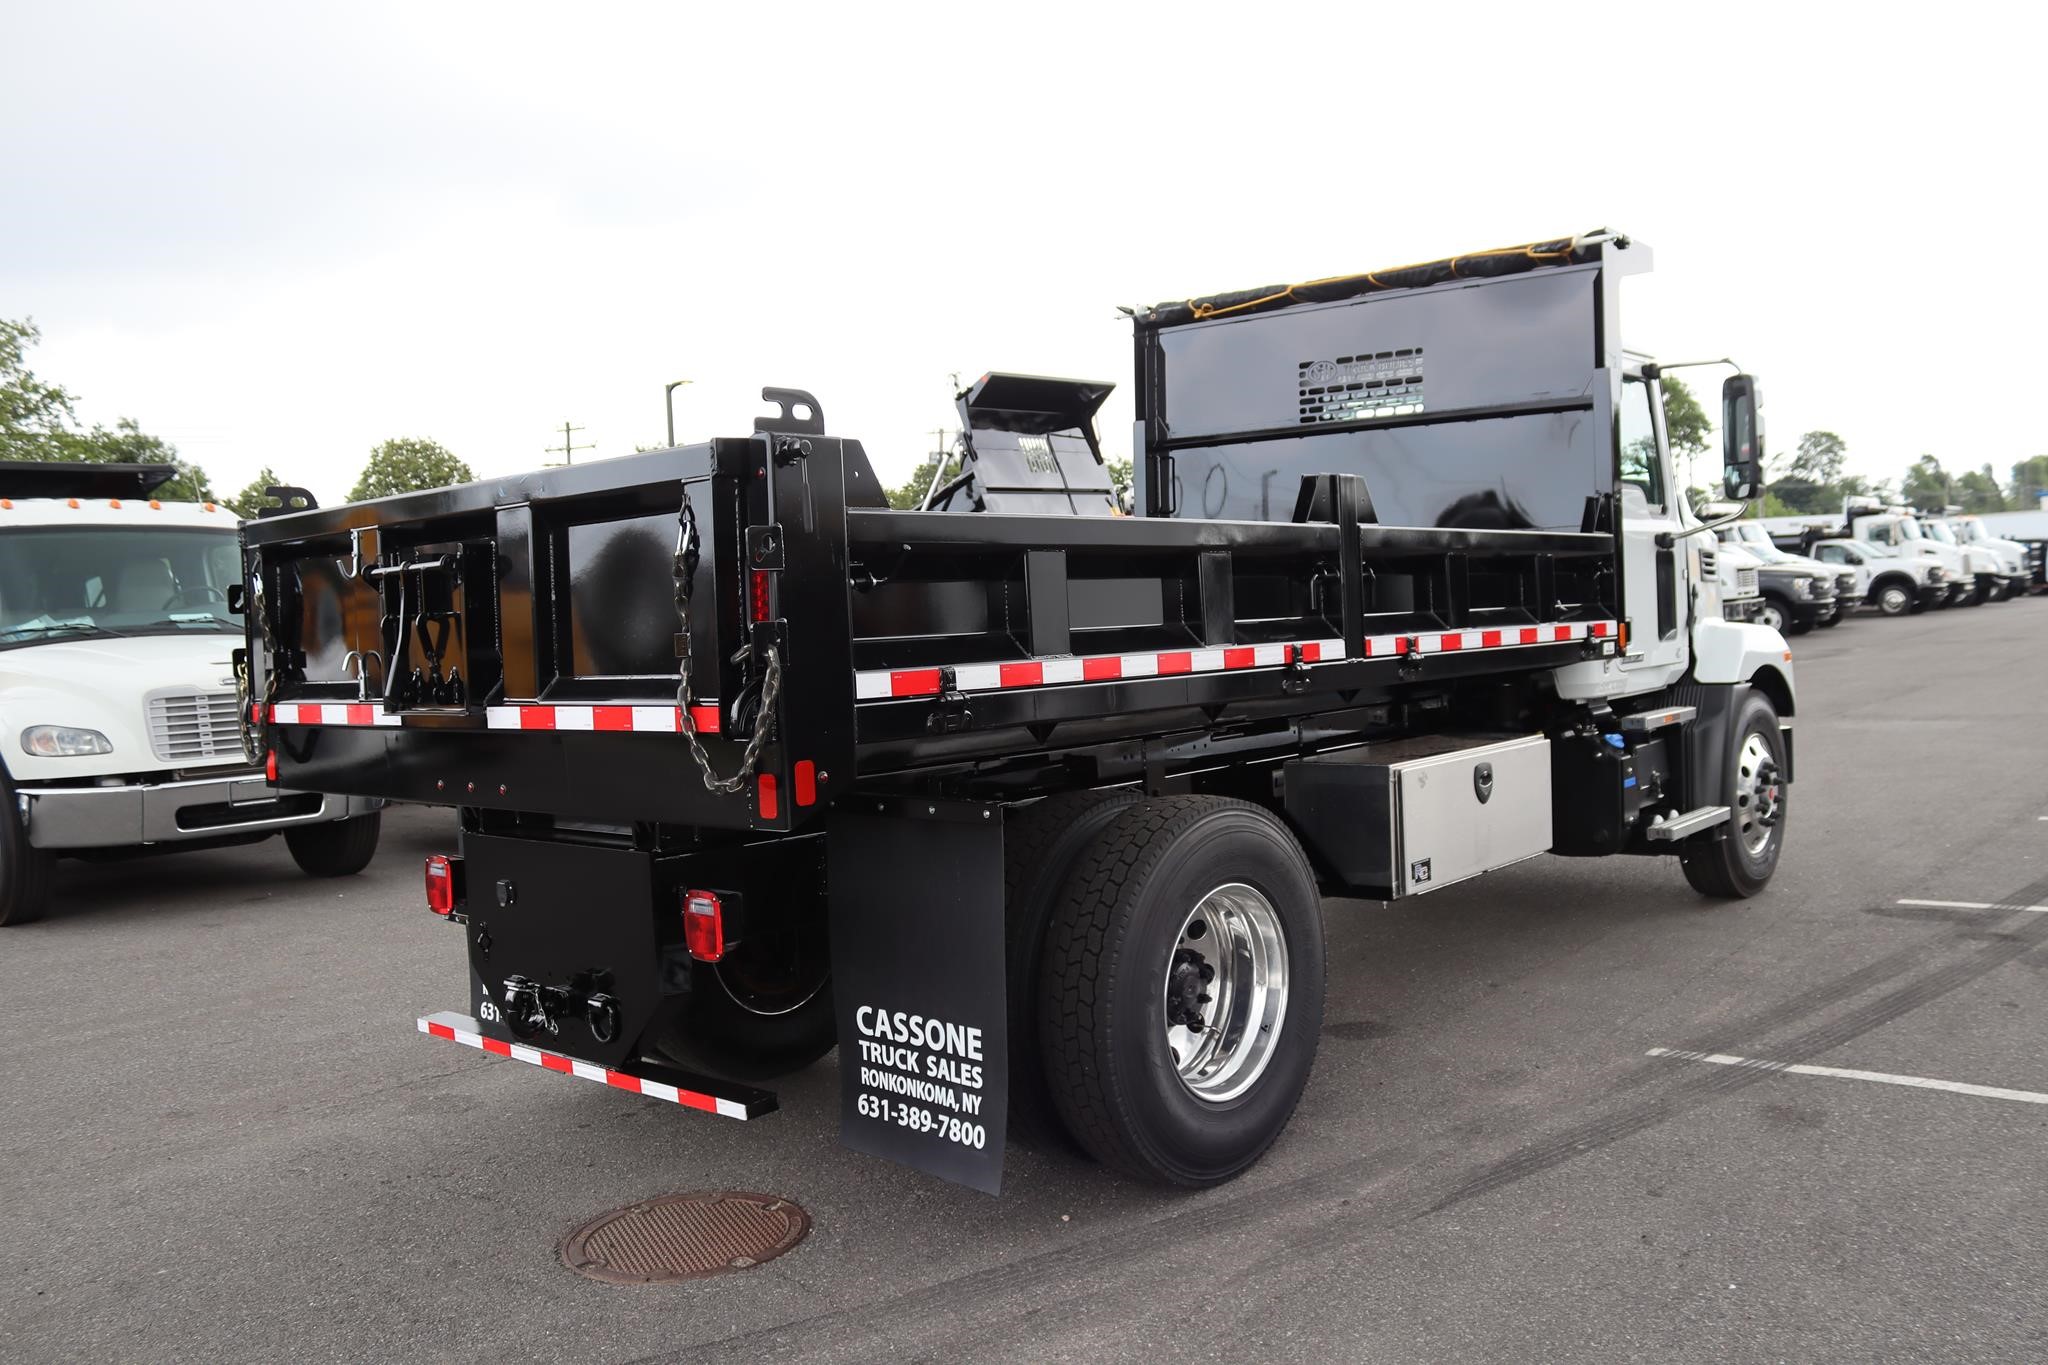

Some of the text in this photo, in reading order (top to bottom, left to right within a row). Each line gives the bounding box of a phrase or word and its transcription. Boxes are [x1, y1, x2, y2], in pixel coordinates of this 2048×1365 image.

[856, 1005, 983, 1061] CASSONE
[858, 1039, 983, 1089] TRUCK SALES
[860, 1066, 982, 1116] RONKONKOMA, NY
[857, 1093, 986, 1150] 631-389-7800
